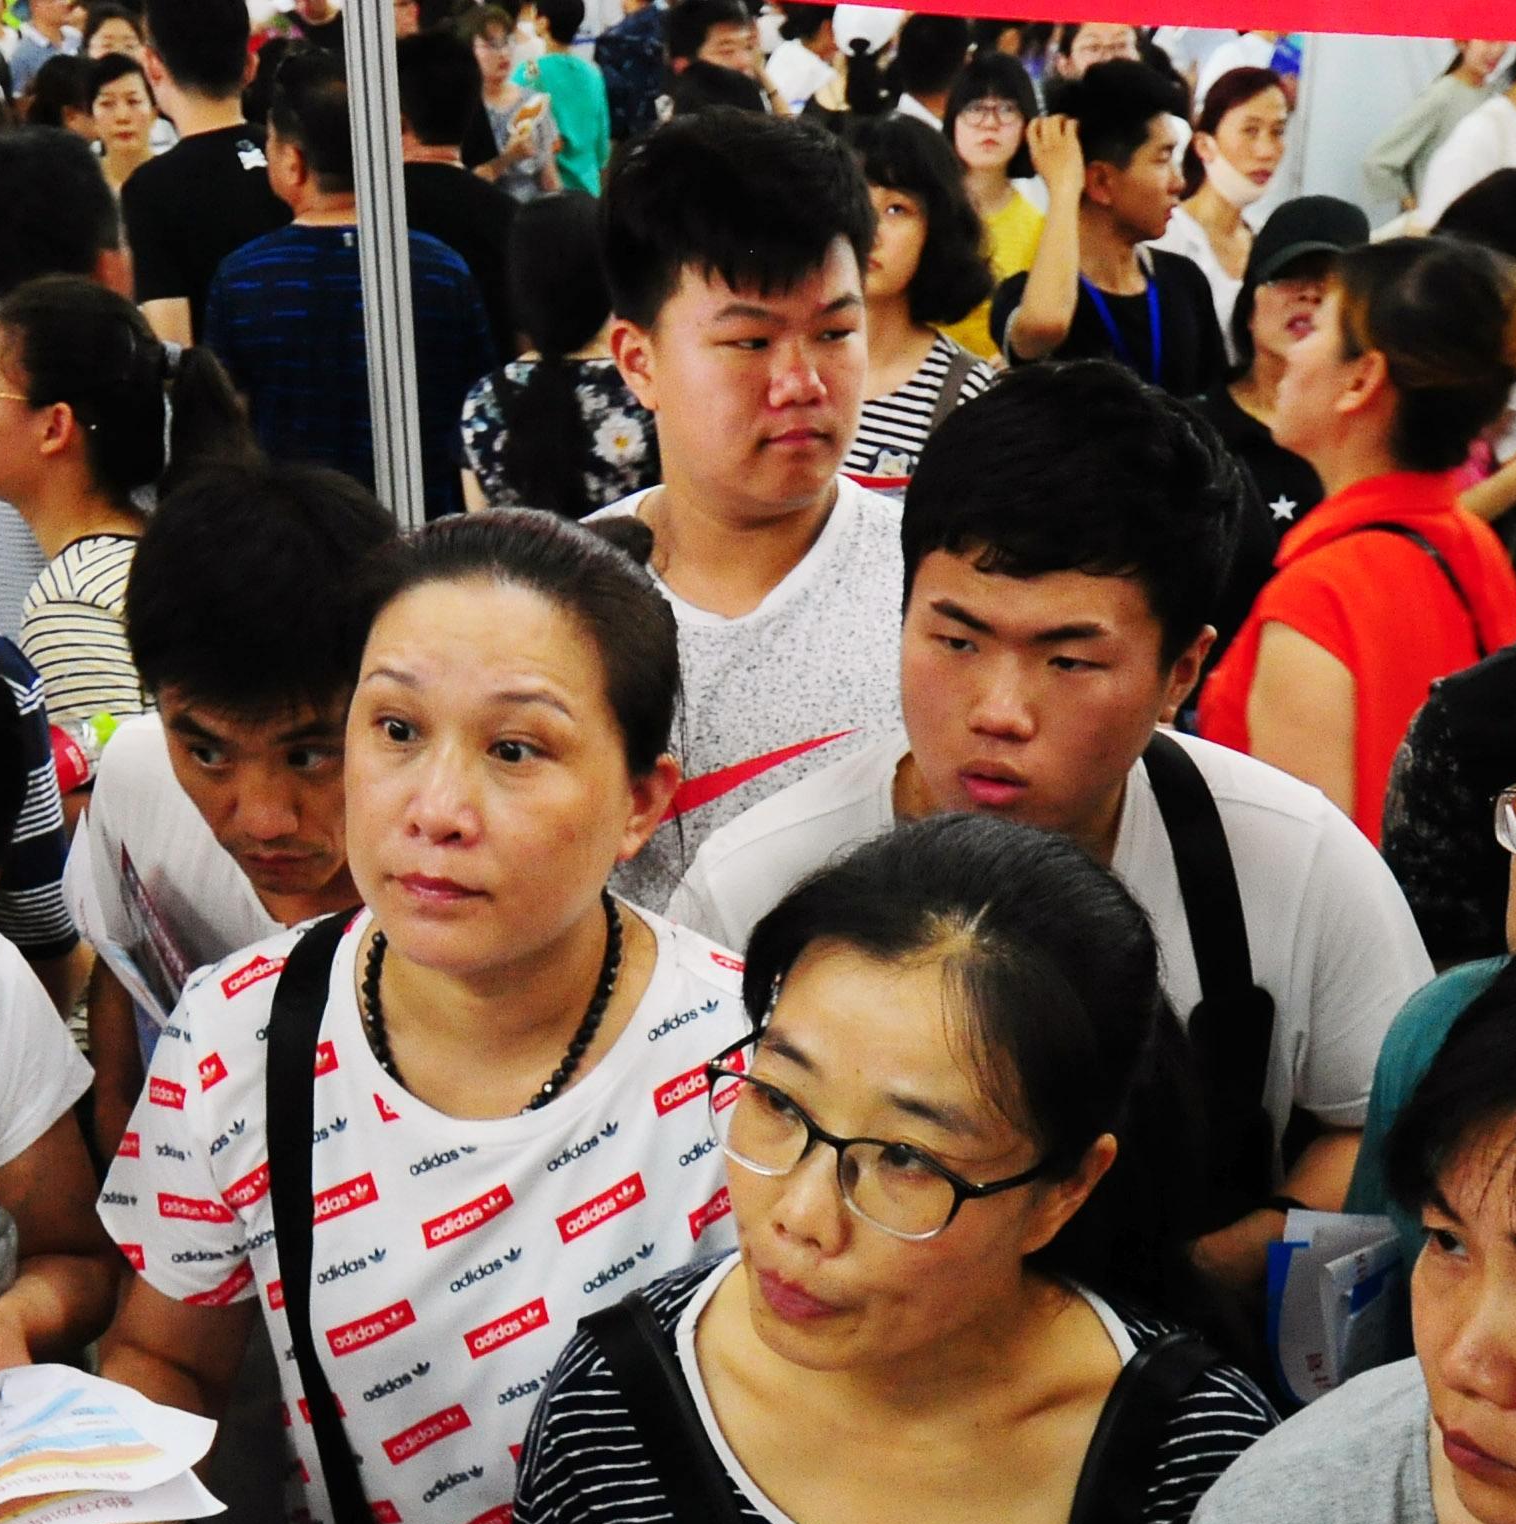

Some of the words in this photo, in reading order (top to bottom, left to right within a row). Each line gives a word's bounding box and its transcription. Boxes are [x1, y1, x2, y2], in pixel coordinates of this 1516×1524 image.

[648, 1009, 698, 1042] adidas
[661, 1072, 707, 1106] adida
[410, 1149, 459, 1176] adidas
[547, 1135, 599, 1172] adidas
[430, 1206, 482, 1240] adidas
[566, 1199, 616, 1236] adidas
[317, 1256, 366, 1285] adidas
[450, 1258, 503, 1293] adidas
[583, 1256, 635, 1294] adidas
[334, 1321, 384, 1349] adidas
[474, 1319, 521, 1350] adidas
[363, 1372, 412, 1402] adidas
[498, 1378, 539, 1405] adidas
[392, 1422, 442, 1456] adidas
[423, 1471, 470, 1504] adidas
